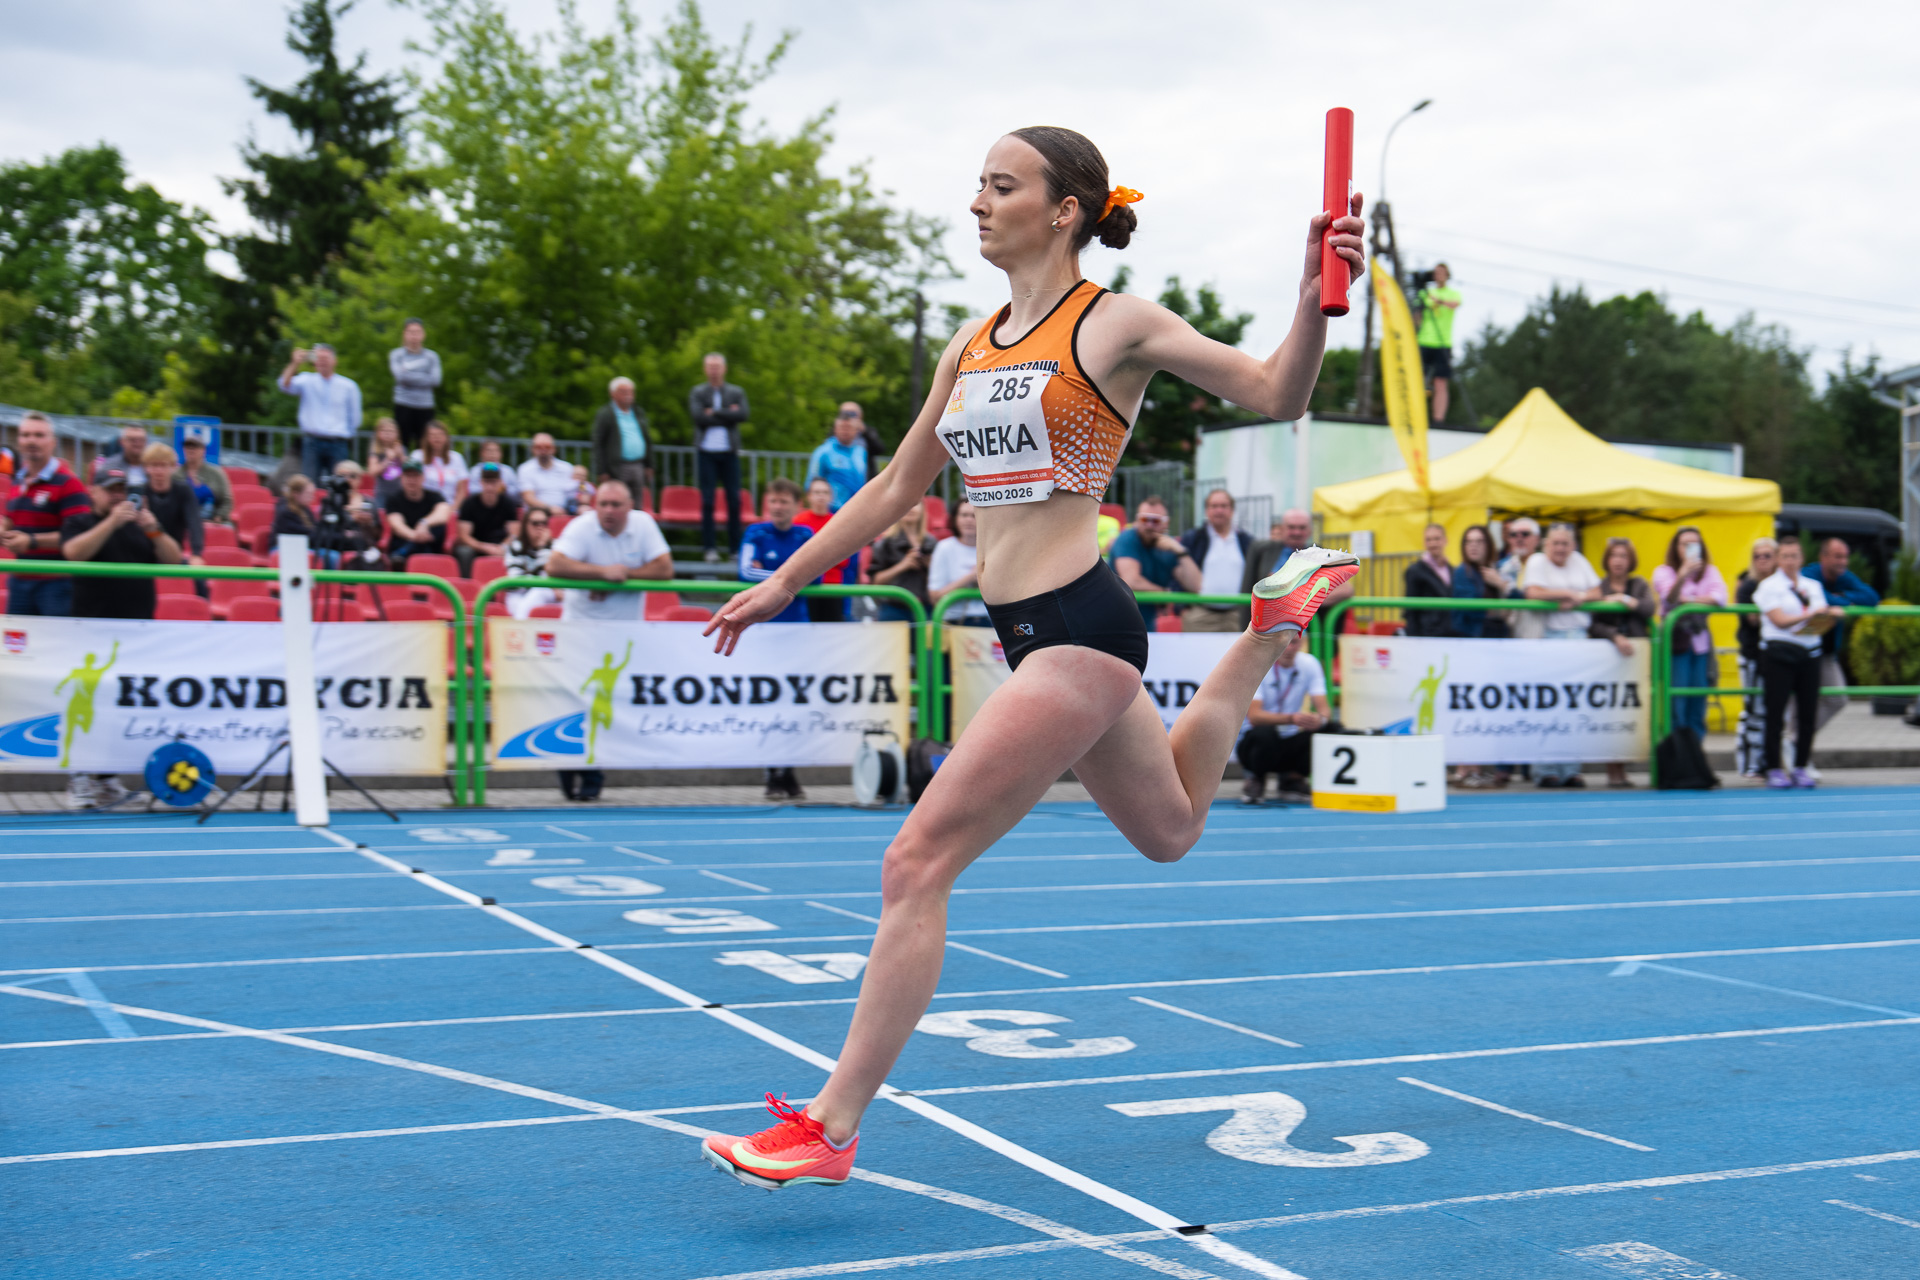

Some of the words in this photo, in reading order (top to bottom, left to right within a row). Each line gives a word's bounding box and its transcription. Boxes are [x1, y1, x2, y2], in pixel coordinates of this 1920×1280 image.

[988, 376, 1034, 403] 285
[943, 423, 1039, 459] DENEKA
[1004, 486, 1033, 500] 2026
[631, 675, 898, 705] KONDYCJA
[1448, 681, 1642, 710] KONDYCJA
[1332, 746, 1357, 785] 2
[530, 874, 666, 896] 6
[622, 907, 781, 934] 5
[712, 949, 869, 984] 4
[914, 1009, 1137, 1058] 3
[1104, 1091, 1432, 1168] 2
